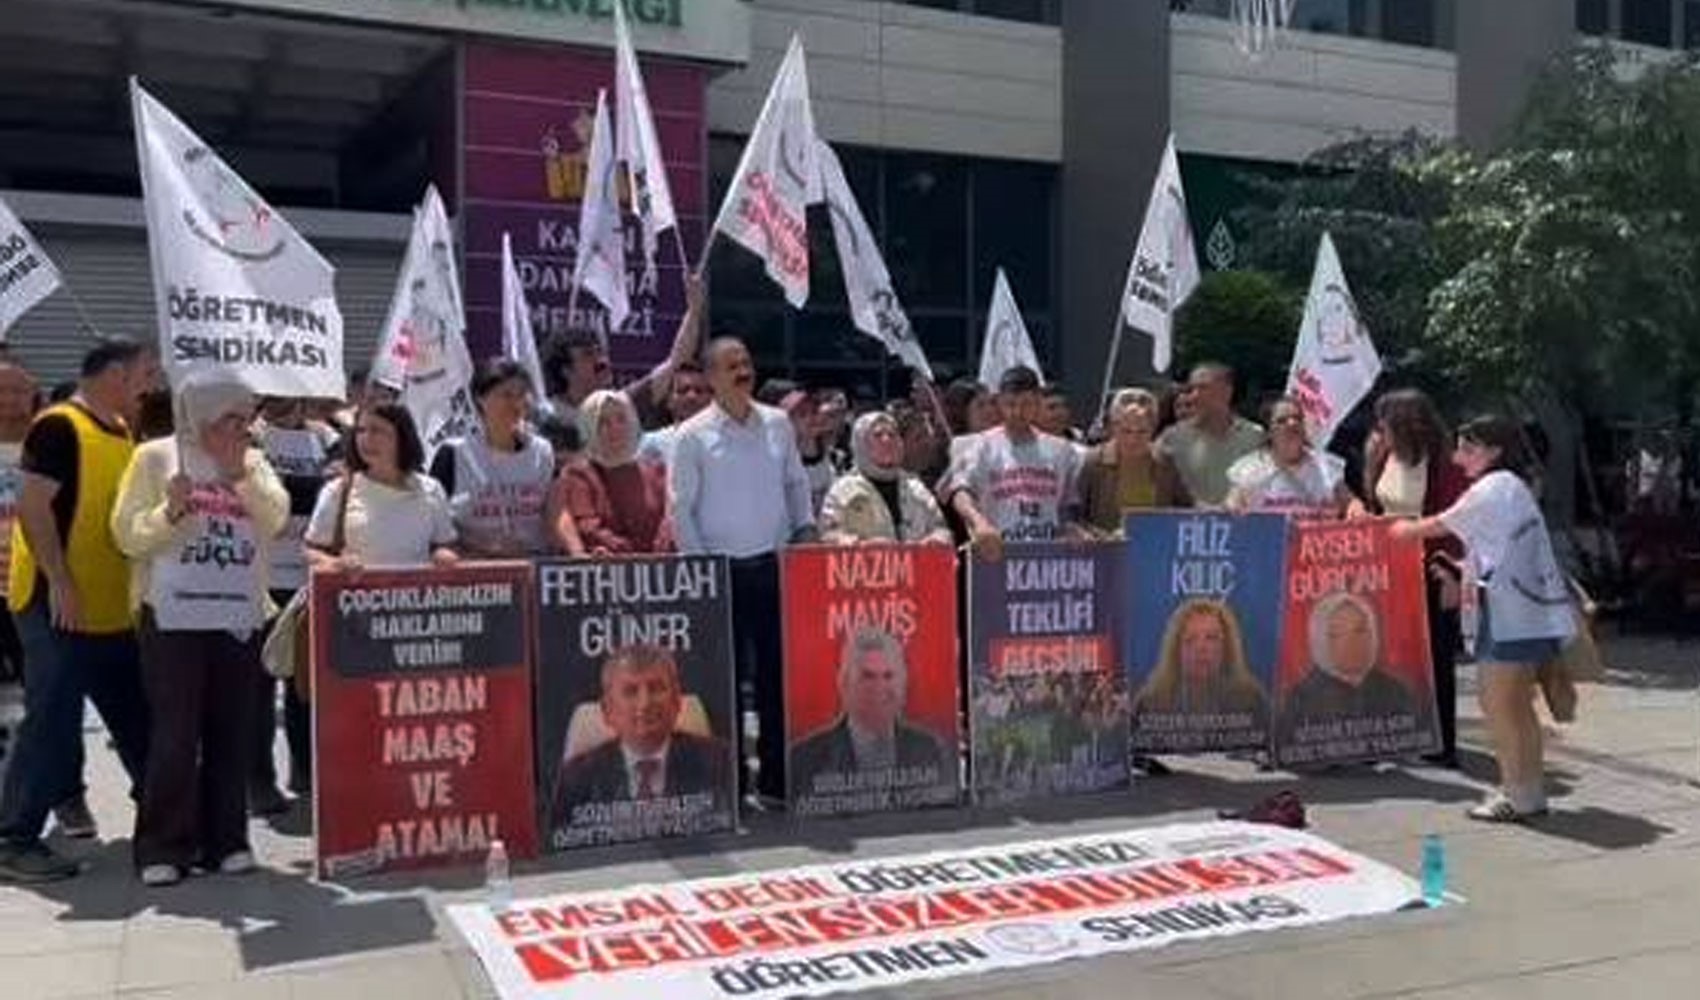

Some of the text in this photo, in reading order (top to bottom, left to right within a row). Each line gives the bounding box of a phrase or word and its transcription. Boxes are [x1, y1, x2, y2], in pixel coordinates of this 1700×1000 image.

[168, 286, 328, 335] ÖĞRETMEN
[173, 331, 328, 369] SENDİKASI
[1177, 514, 1232, 557] FİLİZ
[541, 561, 717, 606] FETHULLAH
[826, 550, 915, 591] NAZIM
[1005, 557, 1095, 592] KANUN
[1171, 558, 1237, 605] KILIÇ
[580, 606, 691, 658] GÜNER
[1005, 592, 1095, 634] TEKLİFİ
[375, 675, 487, 717] TABAN
[382, 722, 476, 766] MAAŞ
[409, 771, 453, 810] VE
[376, 812, 499, 861] ATAMA!
[495, 893, 697, 938] EMSAL
[693, 876, 837, 911] DEĞİL
[538, 908, 828, 969] VERİLEN
[711, 894, 1309, 996] ÖĞRETMEN SENDİKASI
